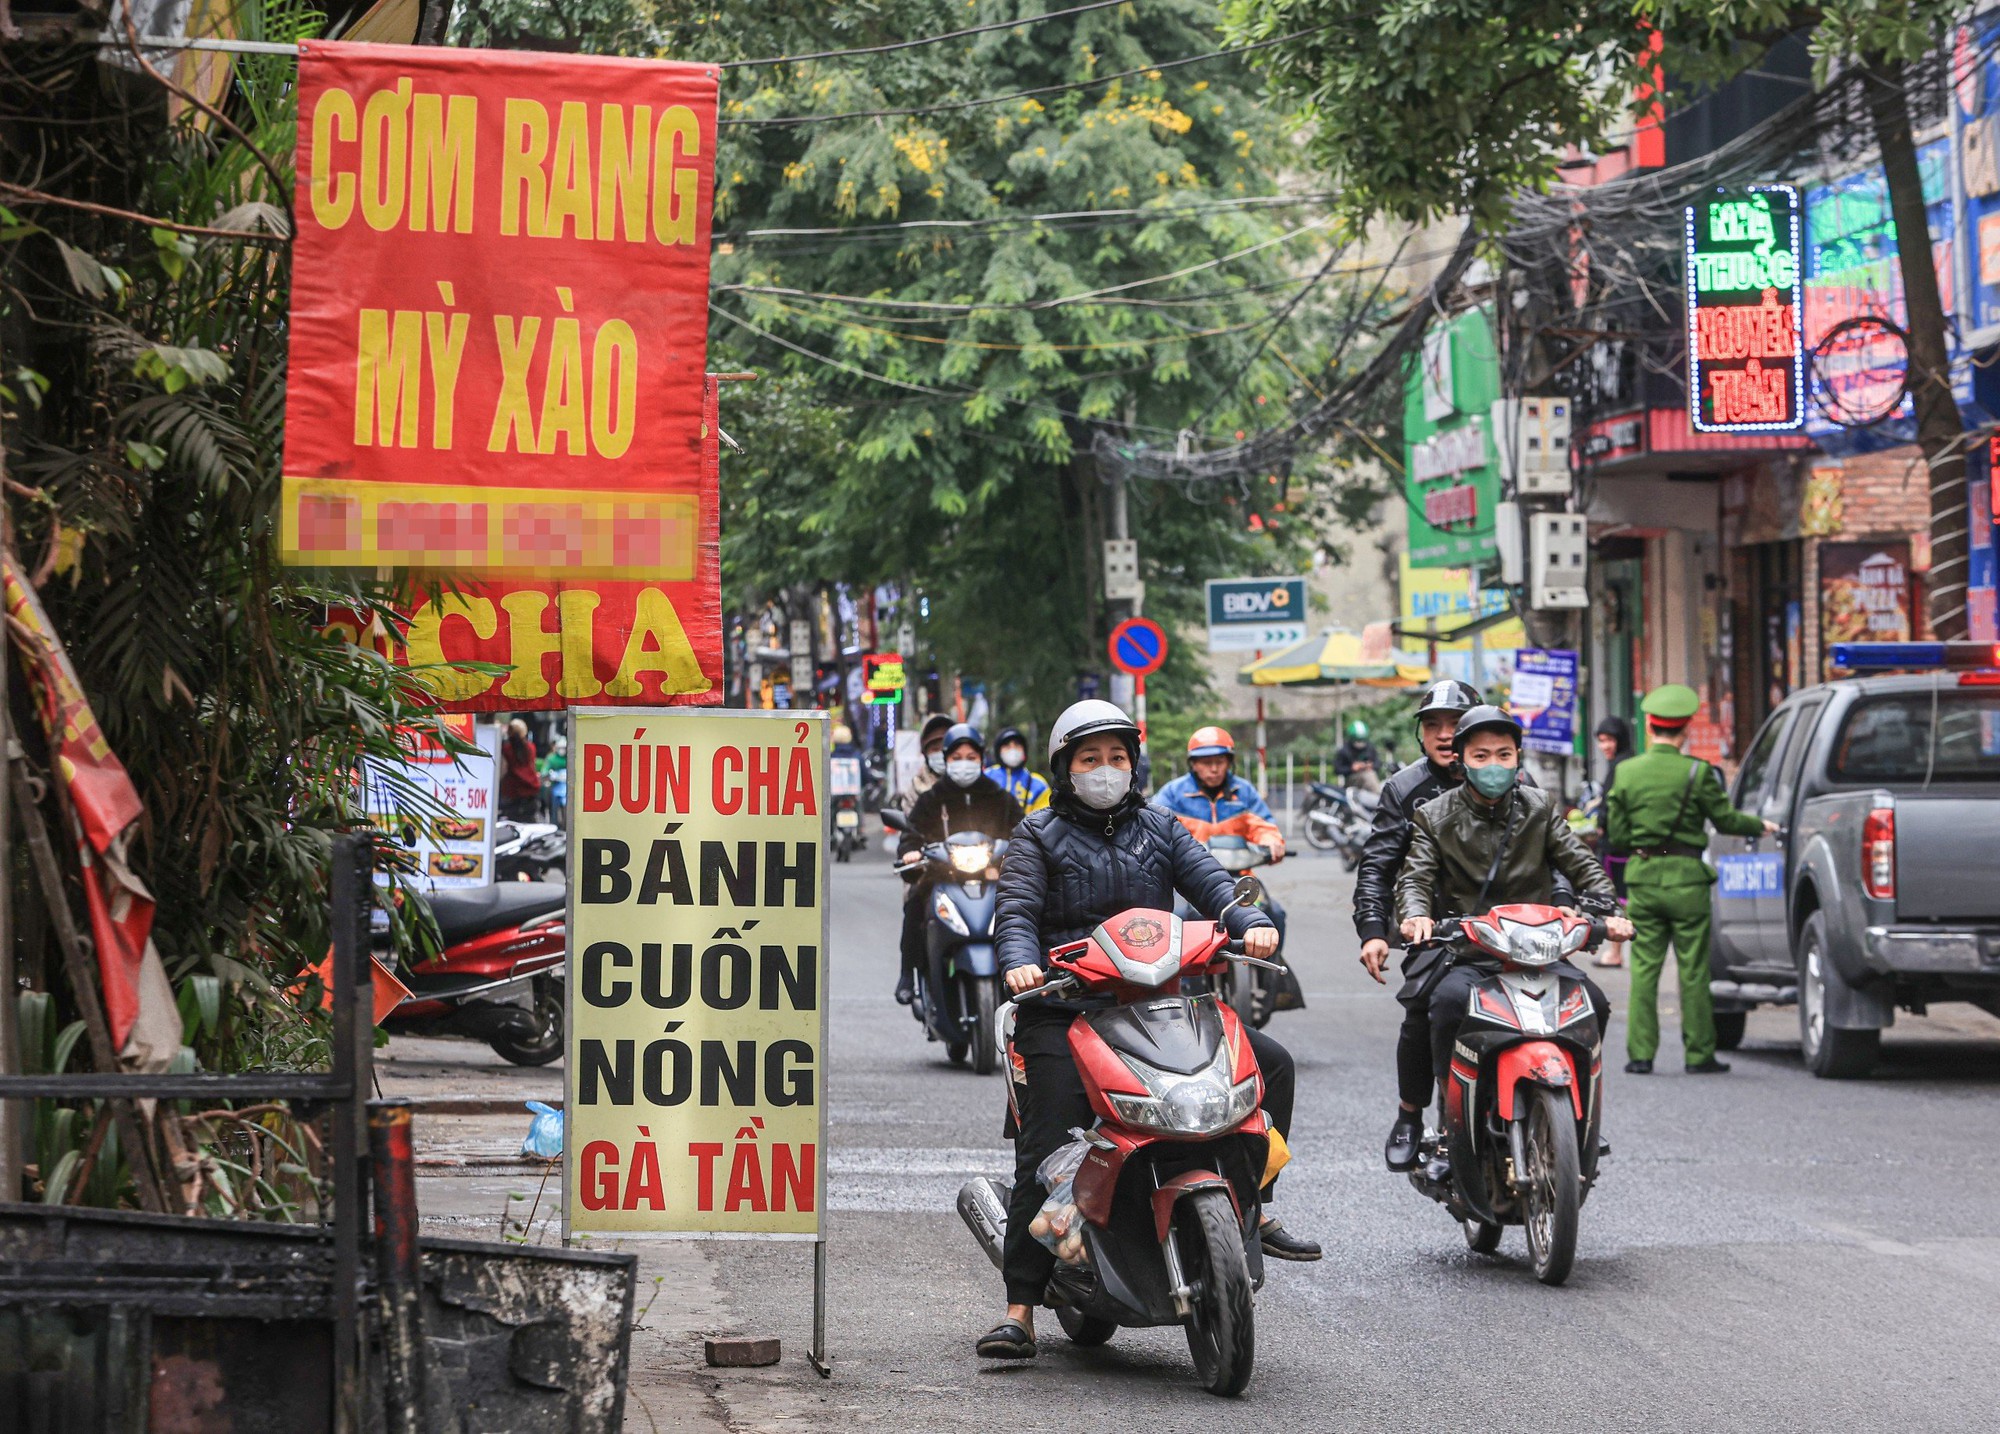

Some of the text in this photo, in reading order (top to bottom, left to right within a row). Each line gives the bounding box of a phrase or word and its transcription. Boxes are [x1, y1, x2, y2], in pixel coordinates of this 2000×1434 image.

[311, 77, 700, 246] CƠM RANG
[354, 281, 638, 459] MỲ XÀO
[1223, 592, 1271, 613] BIDV
[468, 788, 488, 809] 50K
[582, 722, 816, 816] BÚN CHẢ
[580, 823, 816, 907] BÁNH
[581, 920, 816, 1011] CUỐN
[1147, 1003, 1182, 1011] HONDA
[578, 1021, 814, 1108] NÓNG
[580, 1116, 816, 1213] GÀ TẦN
